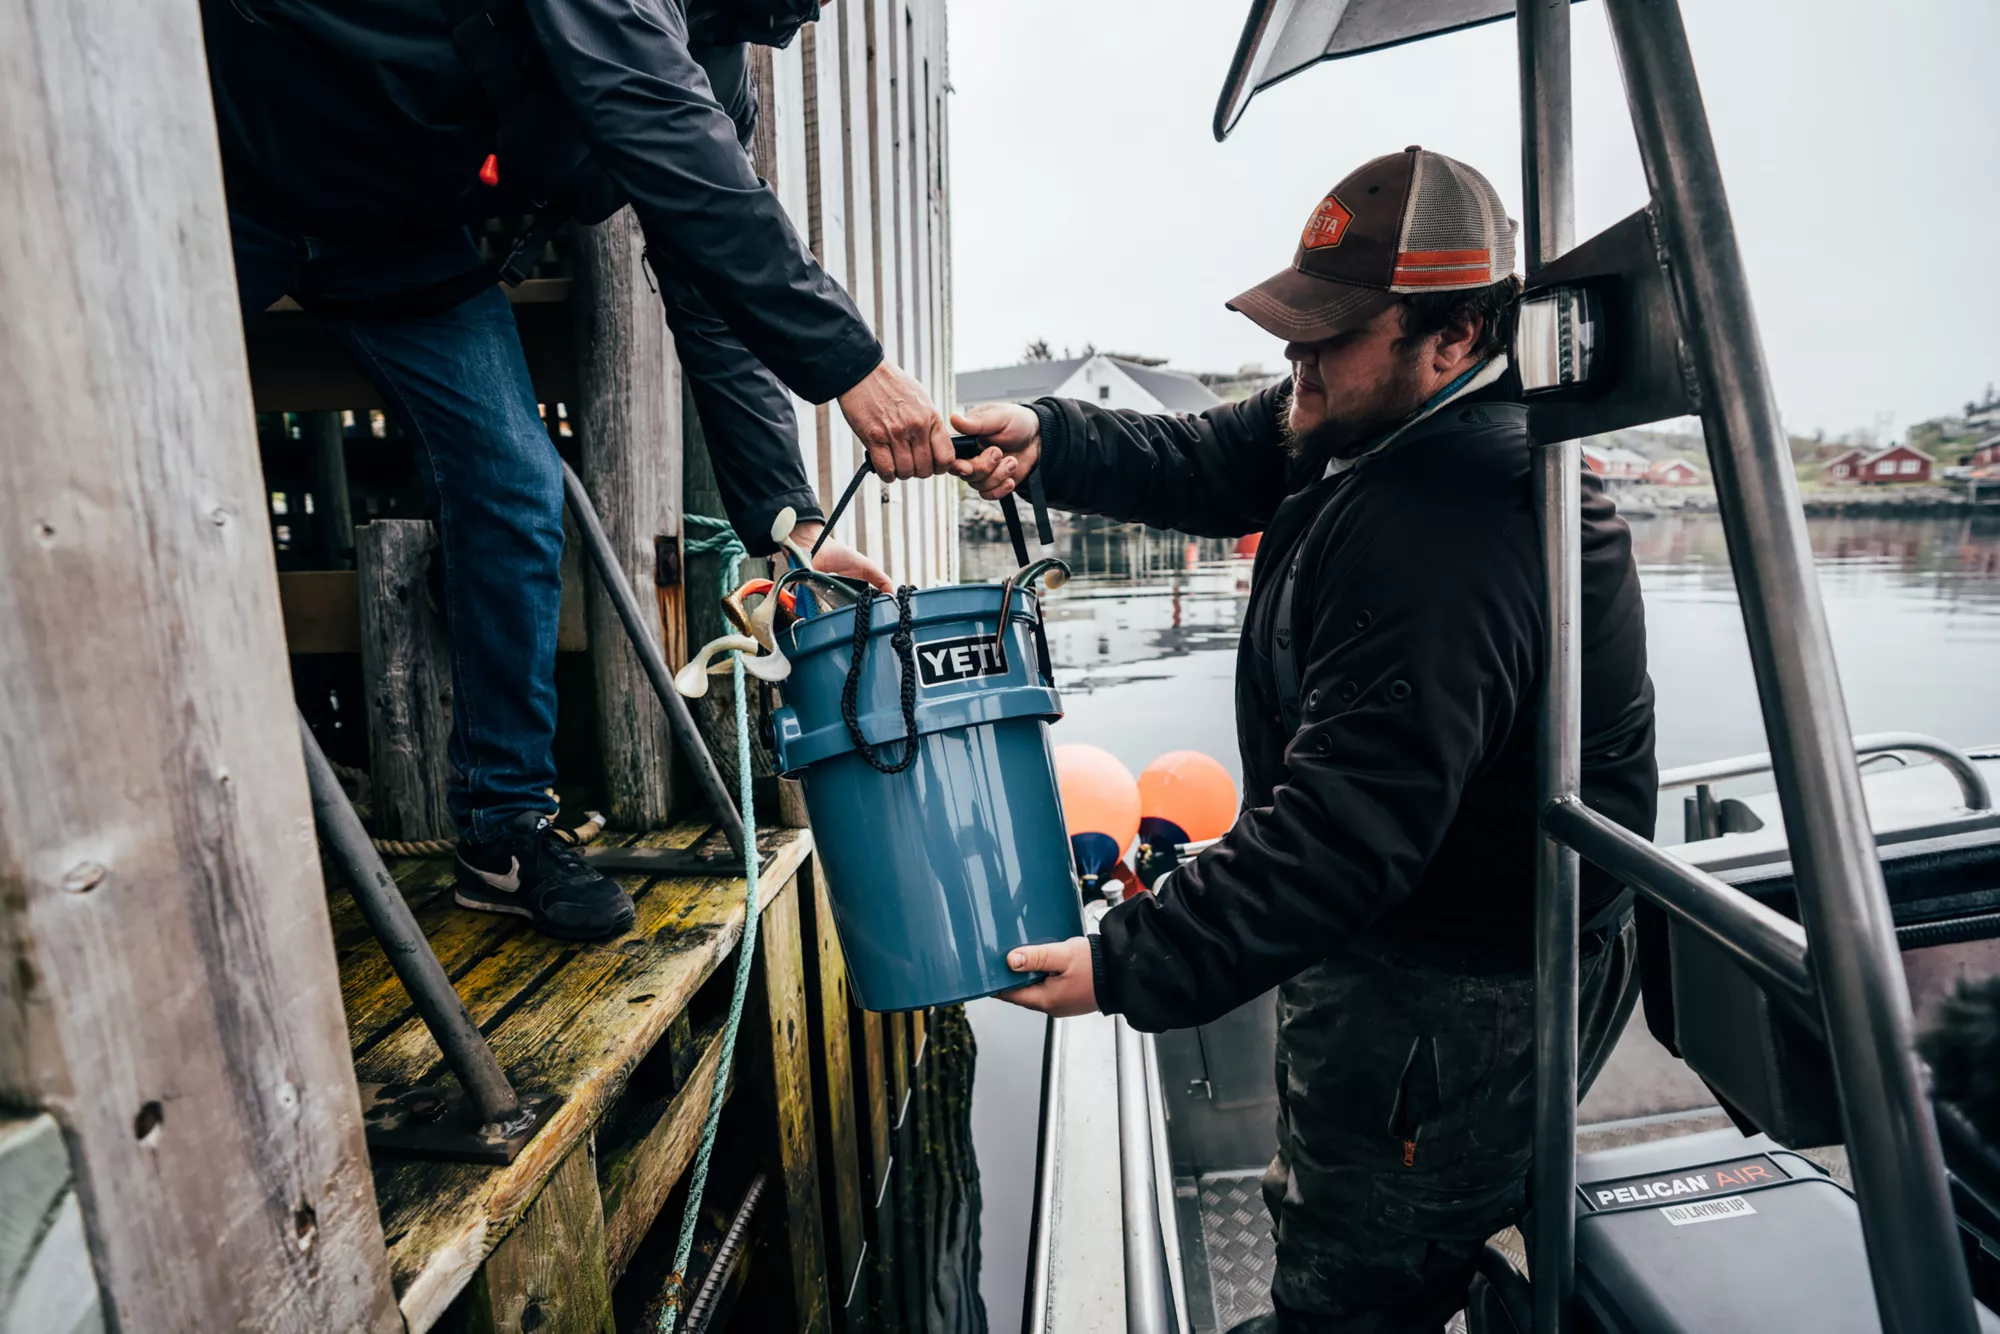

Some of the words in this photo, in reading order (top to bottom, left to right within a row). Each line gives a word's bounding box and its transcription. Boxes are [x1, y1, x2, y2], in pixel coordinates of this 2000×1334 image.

[1306, 213, 1338, 234] STA
[921, 643, 1002, 677] YETI
[1596, 1175, 1710, 1205] PELICAN
[1716, 1165, 1773, 1188] AIR
[1666, 1208, 1687, 1221] NO
[1684, 1201, 1731, 1218] LAYING
[1727, 1198, 1745, 1211] UP
